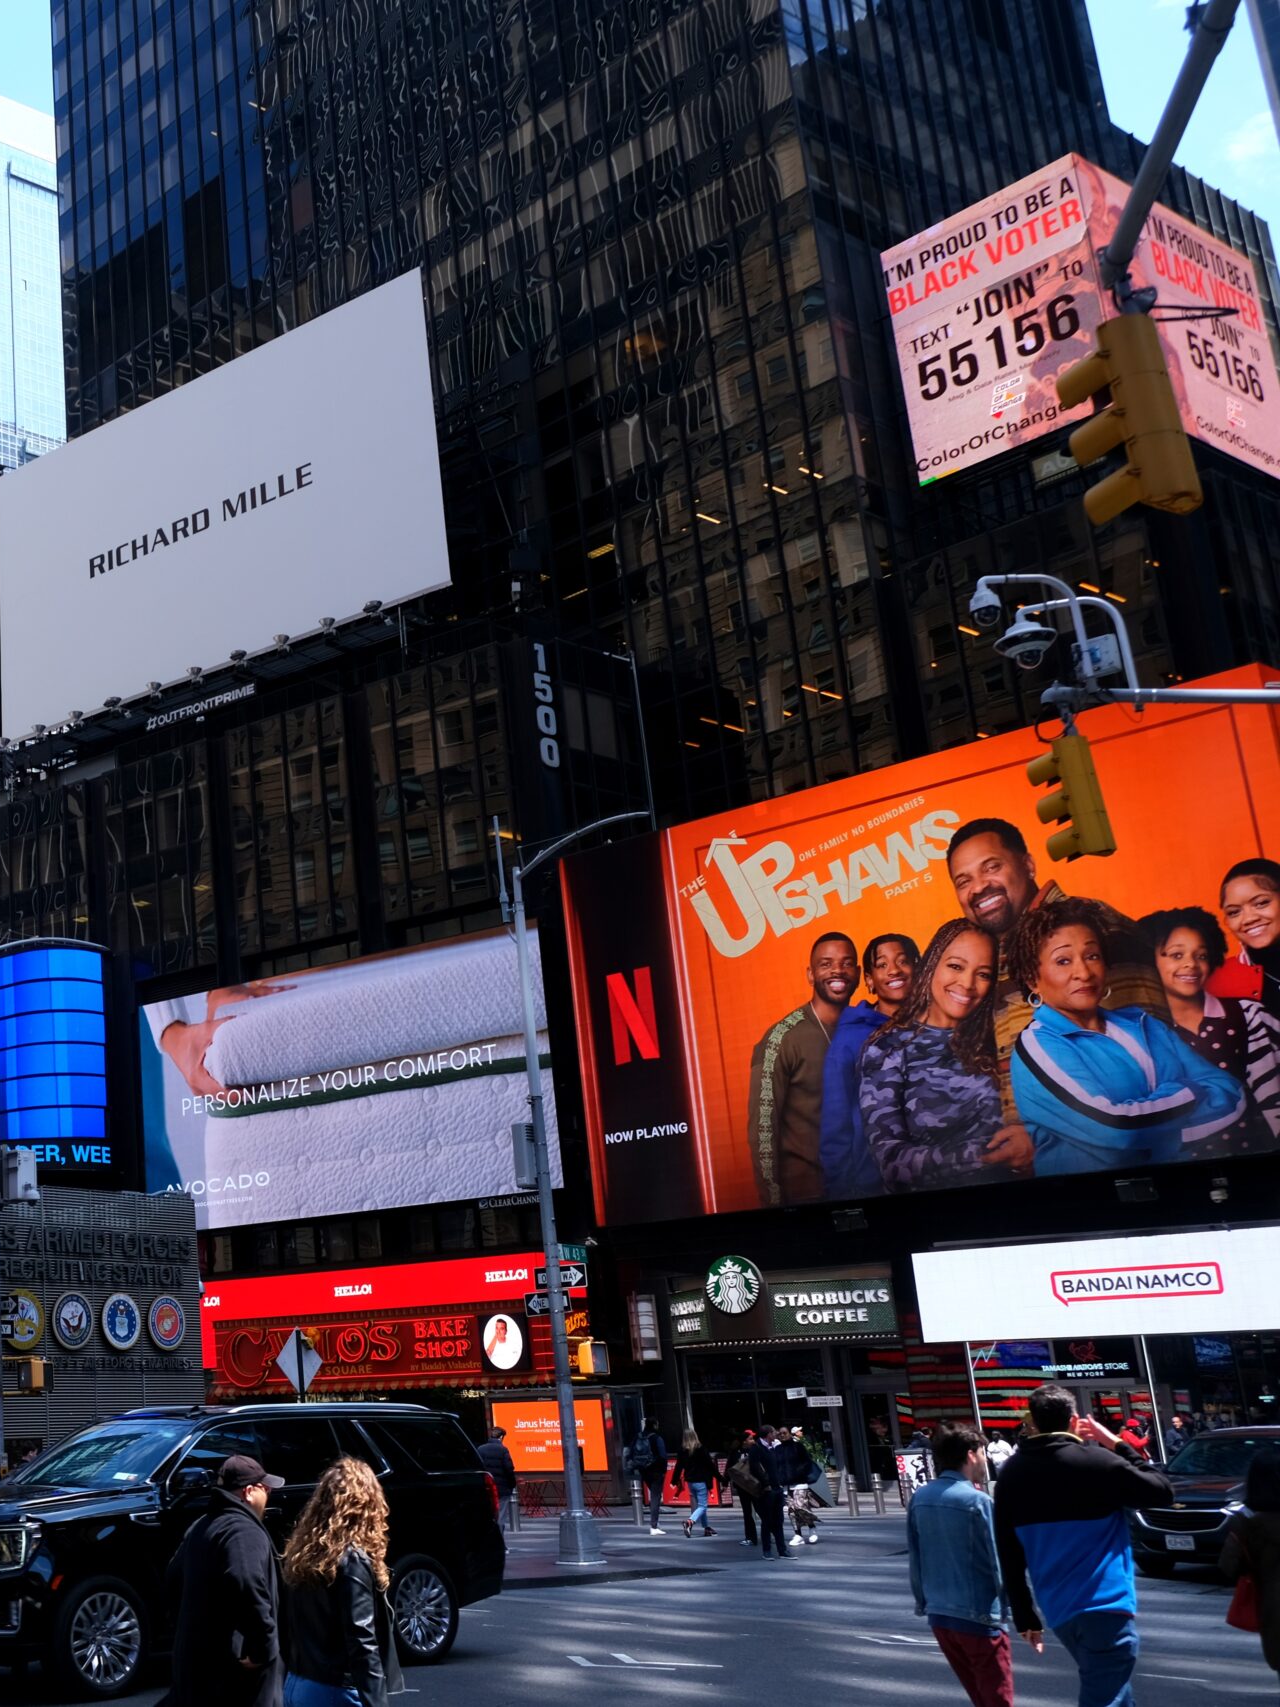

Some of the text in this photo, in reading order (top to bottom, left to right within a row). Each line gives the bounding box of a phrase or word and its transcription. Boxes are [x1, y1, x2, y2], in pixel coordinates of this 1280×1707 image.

[885, 176, 1074, 287] I'M PROUD TO BE A
[888, 199, 1083, 315] BLACK VOTER
[1166, 224, 1208, 268] PROUD
[1208, 249, 1226, 280] TO
[1226, 260, 1244, 291] BE
[1244, 271, 1255, 298] A
[1151, 240, 1209, 302] BLACK
[910, 323, 951, 353] TEXT
[1061, 260, 1083, 281] TO
[918, 294, 1080, 401] 55156
[1186, 329, 1265, 403] 55156
[995, 376, 1021, 393] COLOR
[991, 395, 1024, 413] CHANGE
[89, 461, 314, 579] RICHARD MILLE
[146, 683, 255, 731] #OUTFRONTPRIME
[533, 642, 561, 768] 1500
[799, 796, 925, 862] ONE FAMILY NO BOUNDARIES
[680, 874, 707, 898] THE
[885, 872, 933, 900] PART 5
[182, 1044, 497, 1116] PERSONALIZE YOUR COMFORT
[605, 1121, 688, 1145] NOW PLAYING
[72, 1145, 111, 1164] WEE
[166, 1171, 270, 1195] AVOCADO
[27, 1226, 192, 1260] ARMED FORCES
[563, 1246, 570, 1256] W
[573, 1247, 580, 1260] 43
[0, 1258, 185, 1286] RECRUITING STATION
[334, 1284, 372, 1297] HELLO!
[485, 1268, 528, 1283] HELLO!
[562, 1272, 578, 1281] WAY
[1061, 1271, 1212, 1294] BANDAI NAMCO
[532, 1300, 546, 1308] ONE
[774, 1288, 890, 1308] STARBUCKS
[795, 1307, 869, 1325] COFFEE
[414, 1319, 470, 1339] BAKE
[221, 1320, 401, 1388] CALO'S
[414, 1340, 470, 1360] SHOP
[325, 1364, 373, 1377] SQUARE
[421, 1361, 445, 1373] Buddy
[447, 1359, 482, 1371] Valastro
[1104, 1362, 1129, 1370] STORE
[515, 1418, 538, 1429] Janus
